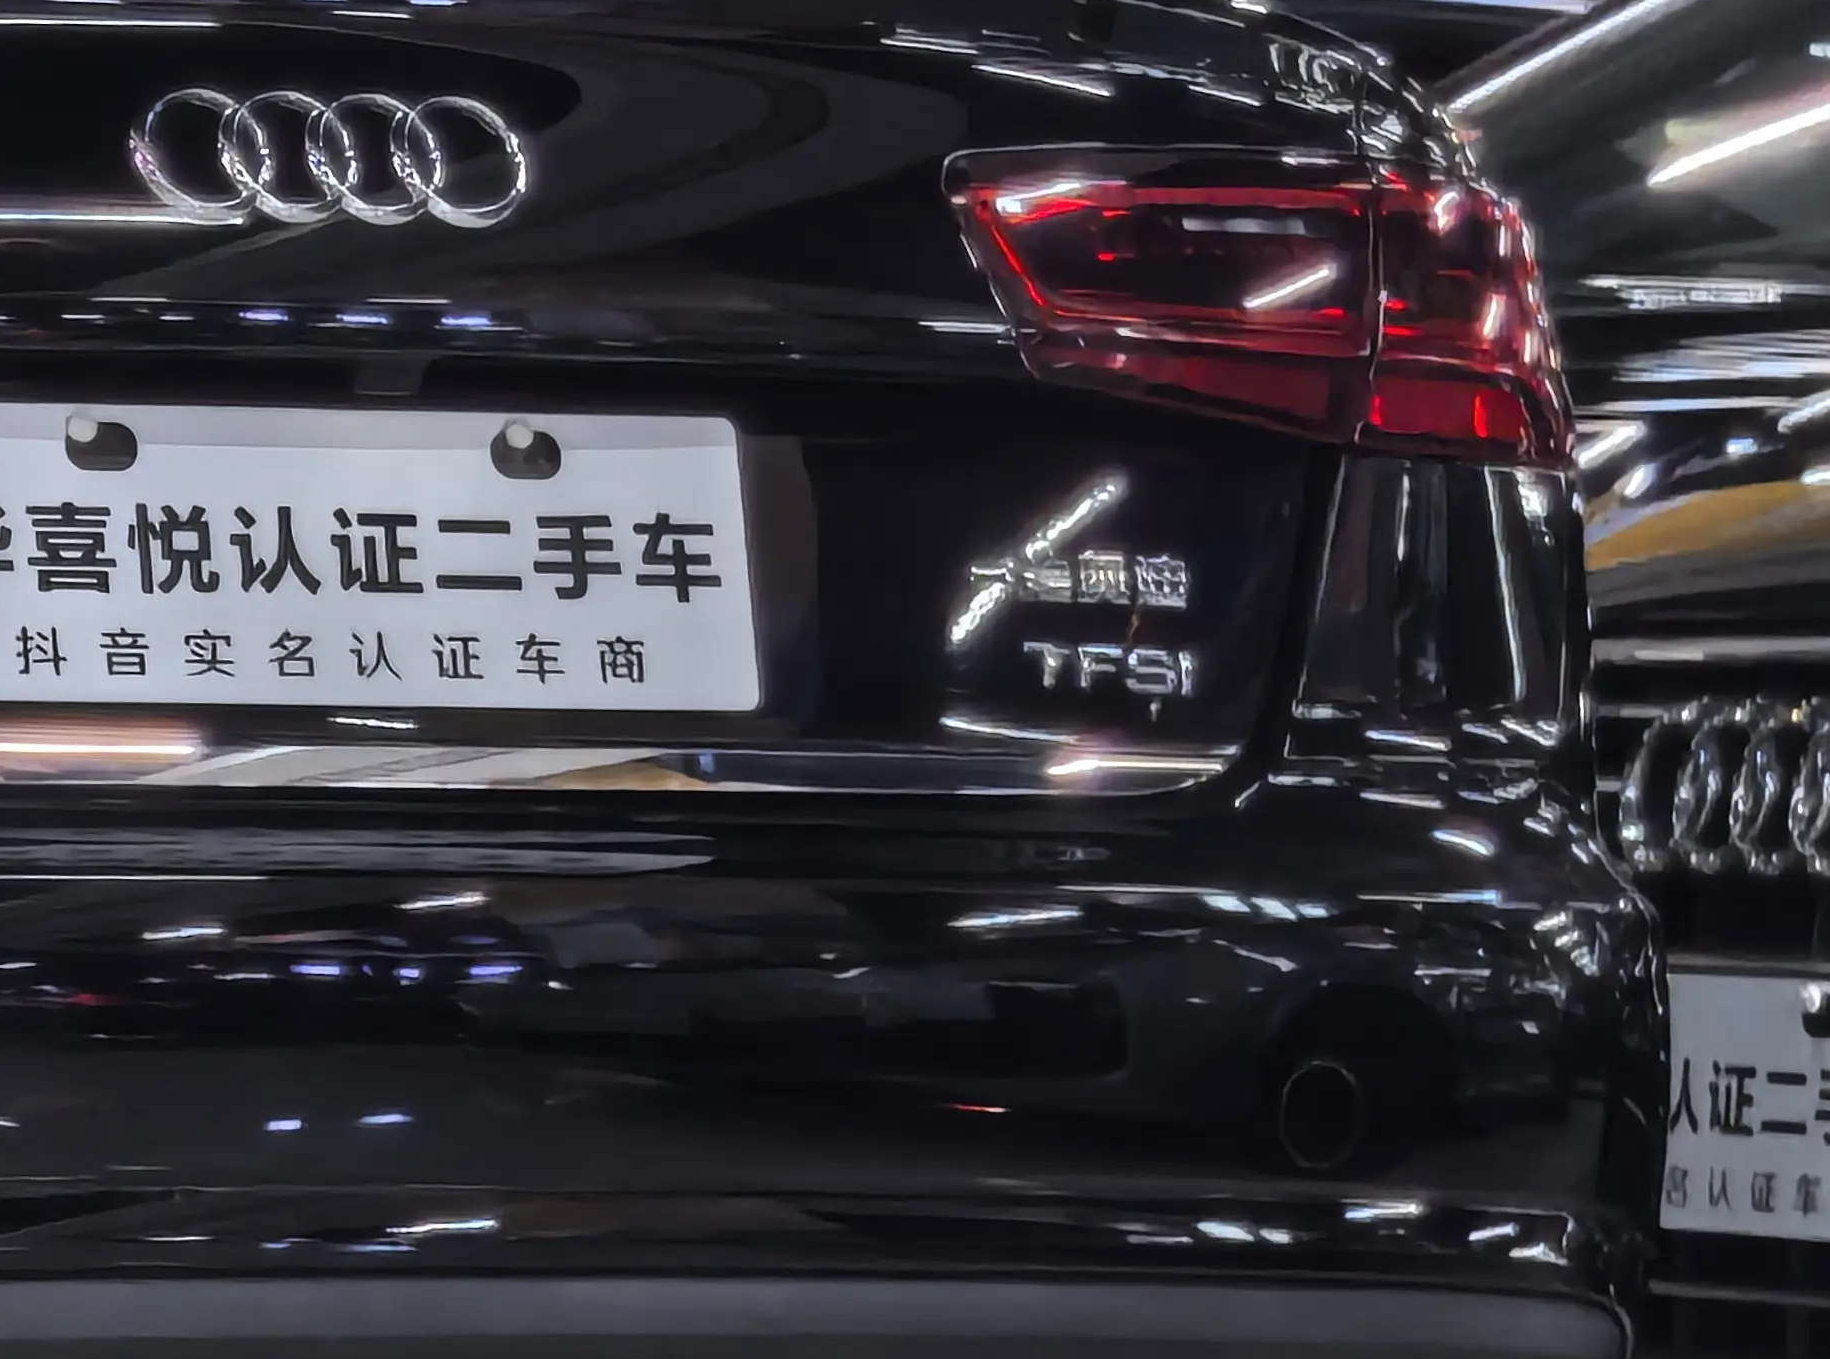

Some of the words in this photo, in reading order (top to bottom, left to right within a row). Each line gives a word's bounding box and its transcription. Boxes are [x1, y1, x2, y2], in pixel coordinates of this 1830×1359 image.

[15, 625, 647, 686] 抖音实名认证车商
[1022, 640, 1195, 697] TFSI
